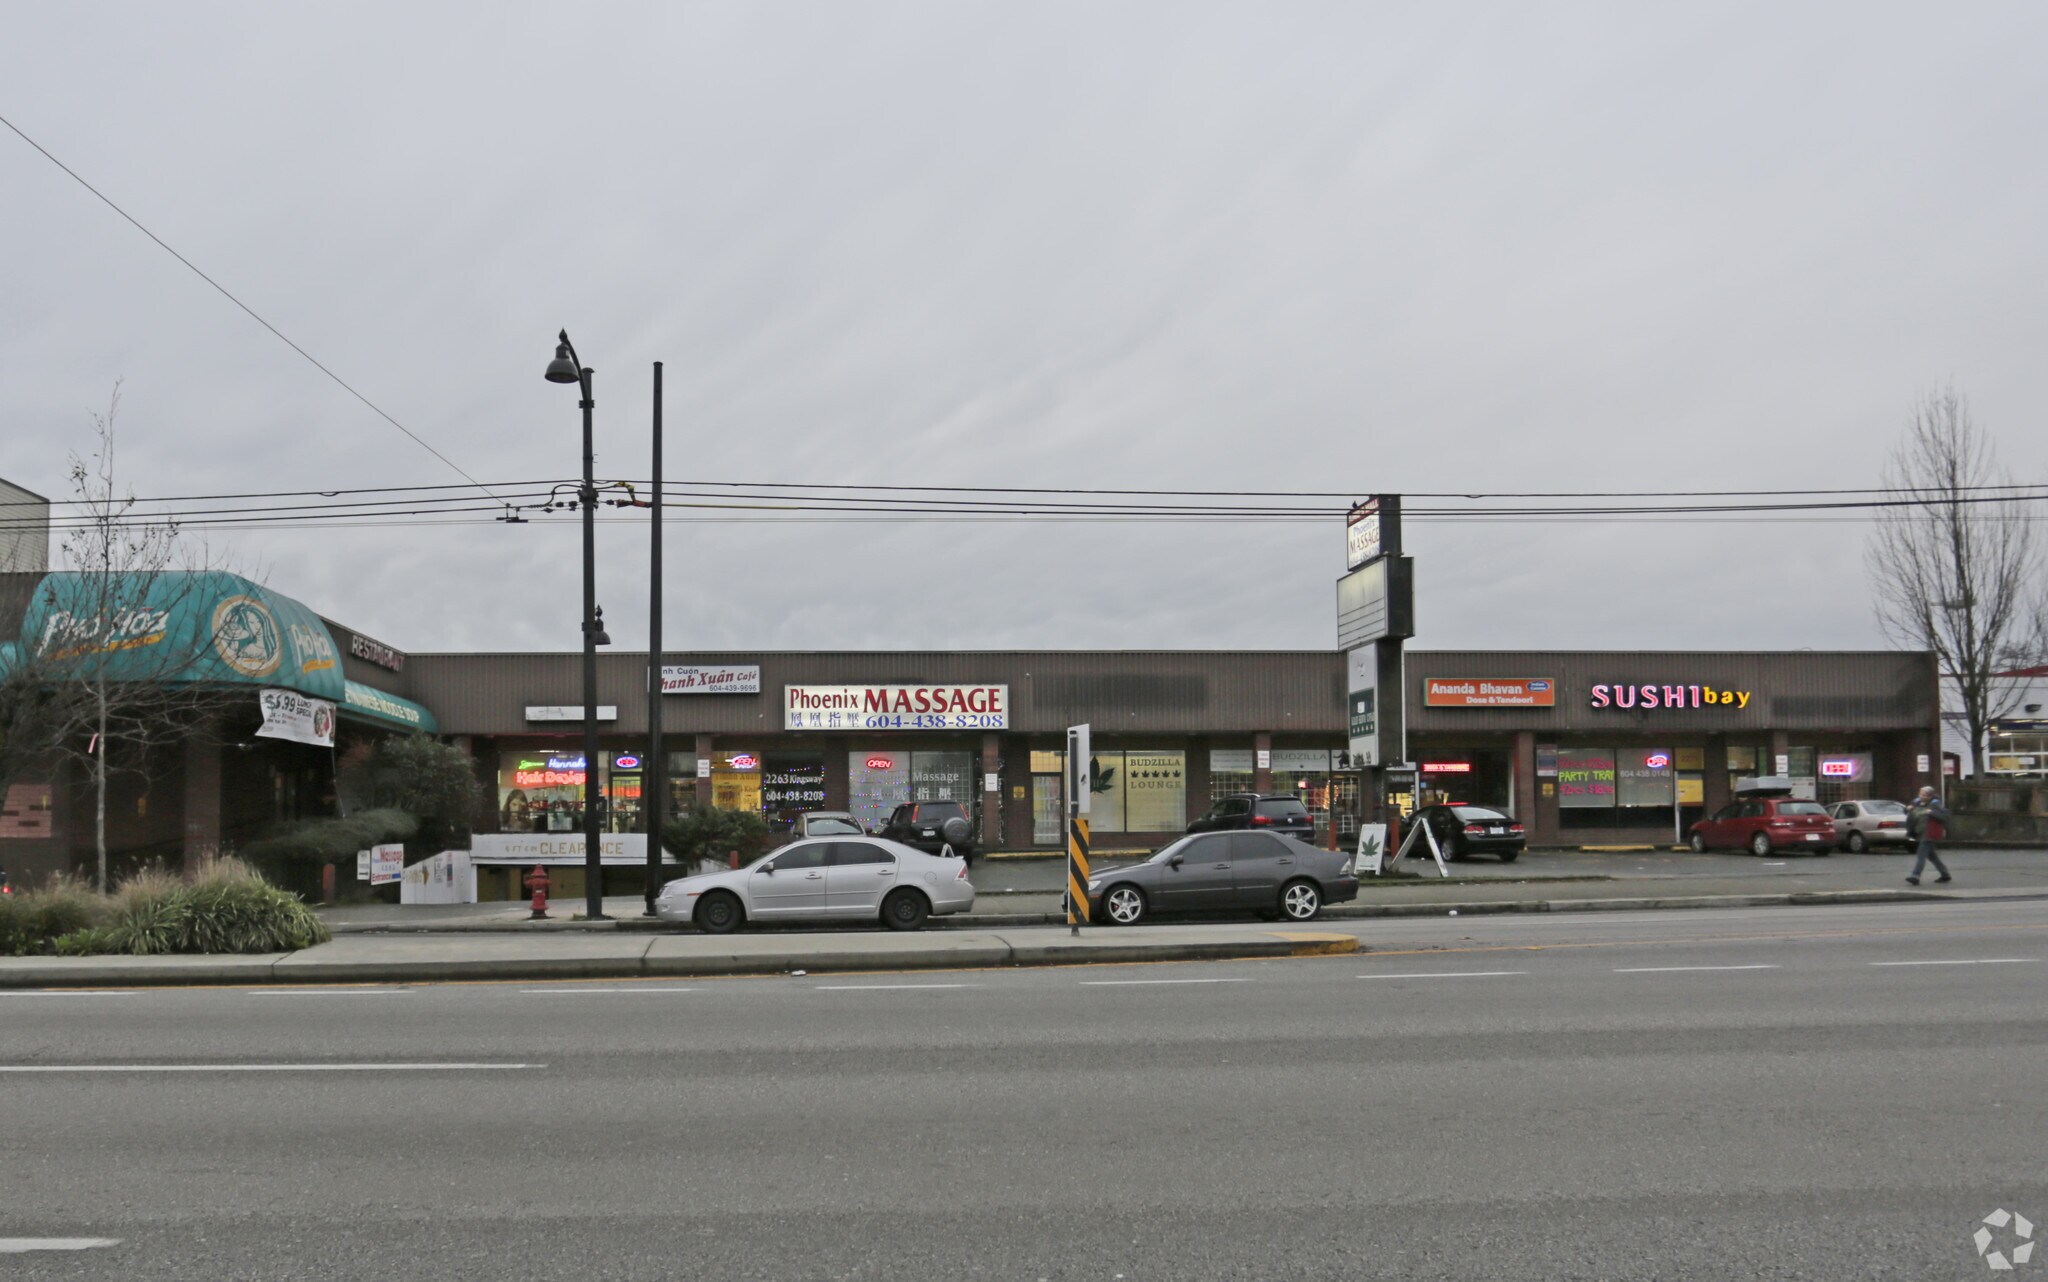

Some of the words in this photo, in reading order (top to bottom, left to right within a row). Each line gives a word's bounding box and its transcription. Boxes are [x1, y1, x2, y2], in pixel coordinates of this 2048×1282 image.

[661, 675, 695, 690] hanh
[1431, 683, 1475, 695] Ananda
[1480, 683, 1522, 695] Bhavan
[789, 688, 859, 709] Phoenix
[863, 688, 1003, 714] MASSAGE
[1591, 685, 1700, 709] SUSHI
[1703, 686, 1750, 709] bay
[865, 714, 1004, 728] 604-438-8208
[731, 758, 758, 766] OPEN
[1130, 758, 1181, 767] BUDZILLA
[1271, 753, 1328, 761] BUDZILLA
[867, 759, 891, 768] OPEN
[516, 771, 543, 784] Hair
[766, 774, 788, 784] 2263
[790, 775, 822, 785] Kingsway
[912, 772, 959, 783] Massage
[1558, 771, 1589, 783] PARTY
[1130, 780, 1182, 789] LOUNGE
[540, 843, 624, 855] CLEARNCE
